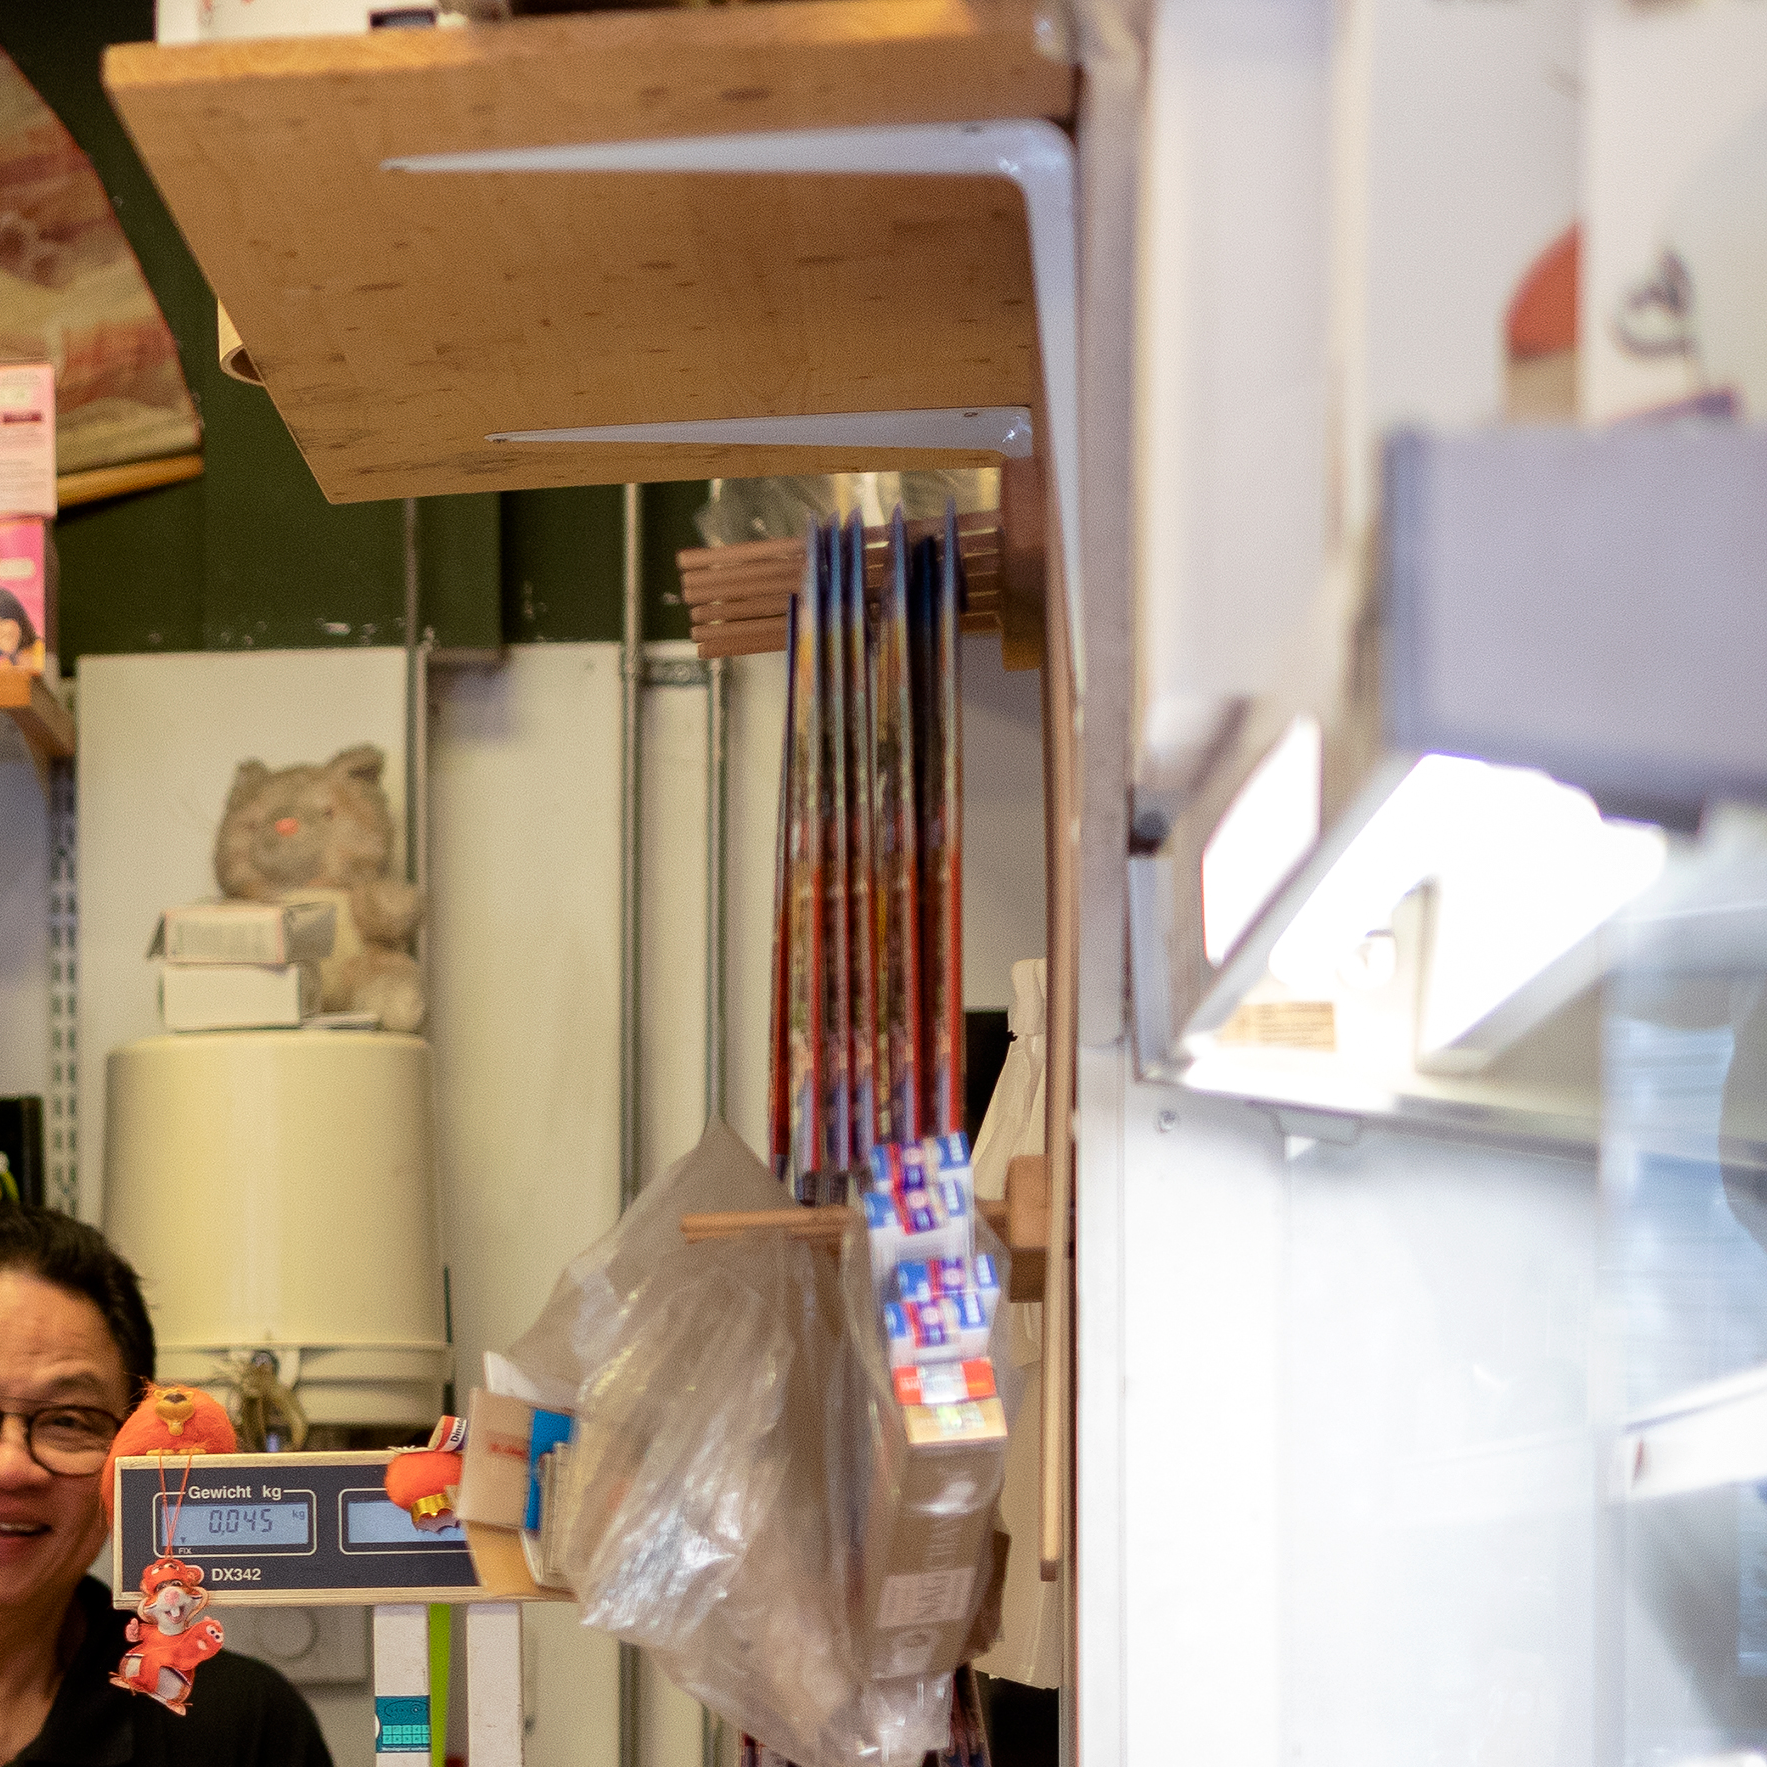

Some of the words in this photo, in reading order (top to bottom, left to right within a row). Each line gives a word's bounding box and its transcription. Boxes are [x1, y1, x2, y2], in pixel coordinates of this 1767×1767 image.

[188, 1485, 251, 1499] Gewicht
[262, 1485, 282, 1500] kg
[292, 1510, 305, 1520] kg
[212, 1569, 261, 1581] DX342
